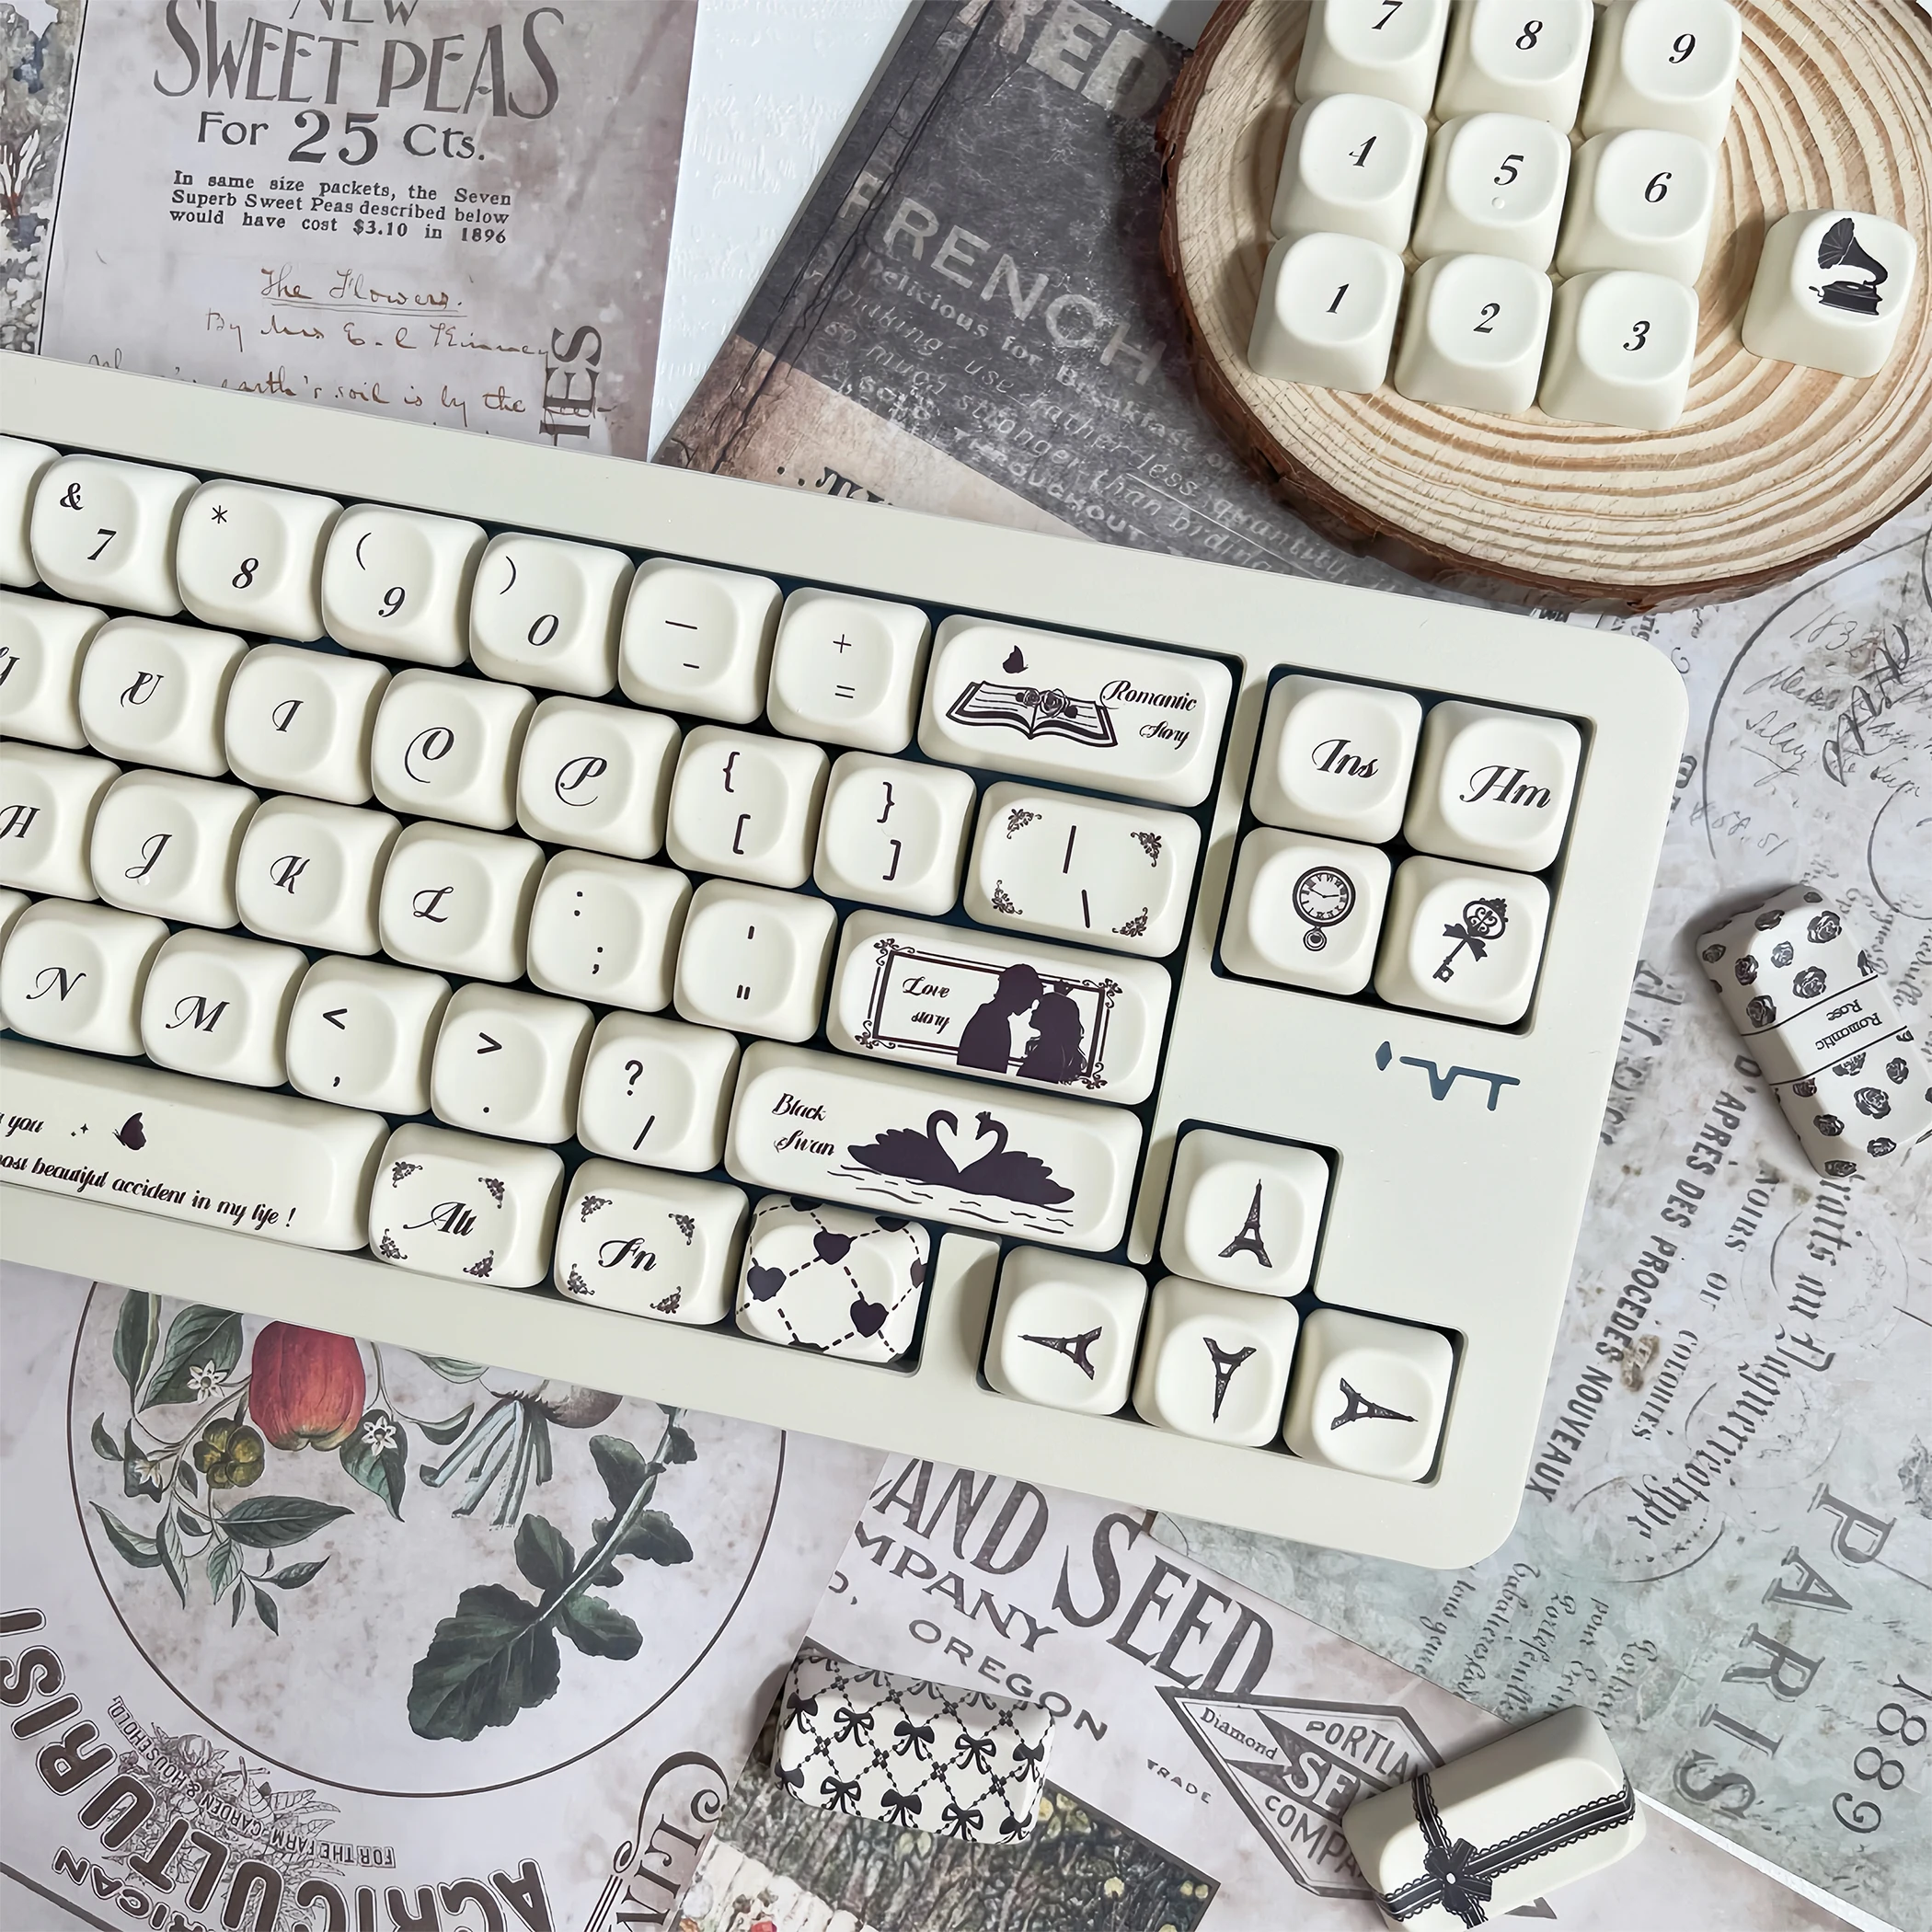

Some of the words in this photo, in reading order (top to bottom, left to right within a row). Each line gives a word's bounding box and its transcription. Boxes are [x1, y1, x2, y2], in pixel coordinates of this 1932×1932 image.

[1372, 0, 1403, 29] 7
[1515, 20, 1543, 50] 8
[1669, 34, 1696, 63] 9
[153, 0, 360, 105] SWEET
[375, 7, 564, 120] PEAS
[197, 110, 269, 147] For
[288, 109, 379, 167] 25
[402, 122, 486, 161] Cts.
[1494, 155, 1524, 185] 5
[1645, 172, 1672, 202] 6
[173, 170, 193, 187] In
[208, 175, 255, 190] same
[269, 175, 305, 192] size
[319, 181, 398, 201] packets,
[408, 183, 438, 201] the
[454, 187, 512, 207] Seven
[171, 188, 237, 208] Superb
[245, 193, 304, 212] Sweet
[311, 196, 354, 215] Peas
[359, 201, 446, 222] described
[454, 204, 510, 225] below
[169, 209, 224, 226] would
[242, 212, 286, 230] have
[301, 217, 339, 233] cost
[352, 220, 408, 239] $3.10
[424, 224, 443, 240] in
[460, 226, 507, 245] 1896
[261, 269, 313, 301] The
[837, 171, 1166, 386] FRENCH
[1327, 283, 1349, 314] 1
[1473, 303, 1500, 333] 2
[1623, 321, 1650, 351] 3
[87, 529, 117, 560] 7
[232, 558, 259, 589] 8
[378, 587, 405, 617] 9
[1097, 681, 1197, 718] Romantic
[1312, 740, 1378, 778] Ins
[270, 856, 310, 894] K
[413, 887, 453, 923] L
[26, 967, 86, 1001] N
[903, 976, 949, 997] Love
[166, 996, 230, 1032] M
[1826, 998, 1863, 1021] Rose
[1815, 1012, 1883, 1052] Romantic
[772, 1093, 825, 1121] Black
[8, 1113, 45, 1137] you
[31, 1156, 109, 1193] beautiful
[111, 1179, 187, 1205] accident
[191, 1190, 212, 1210] in
[216, 1200, 247, 1226] my
[251, 1203, 280, 1231] life
[1661, 1179, 1705, 1228] DES
[403, 1202, 477, 1236] Alt
[598, 1237, 656, 1271] Fn
[1524, 1365, 1613, 1503] NOUVEAUX
[869, 1457, 1049, 1574] AND
[1052, 1512, 1274, 1696] SEED
[1673, 1482, 1898, 1822] PARIS
[908, 1618, 1109, 1742] OREGON
[1200, 1707, 1279, 1761] Diamond
[1146, 1758, 1213, 1804] TRADE
[1283, 1751, 1362, 1812] SE
[321, 1843, 356, 1865] THE
[360, 1846, 395, 1868] FOR
